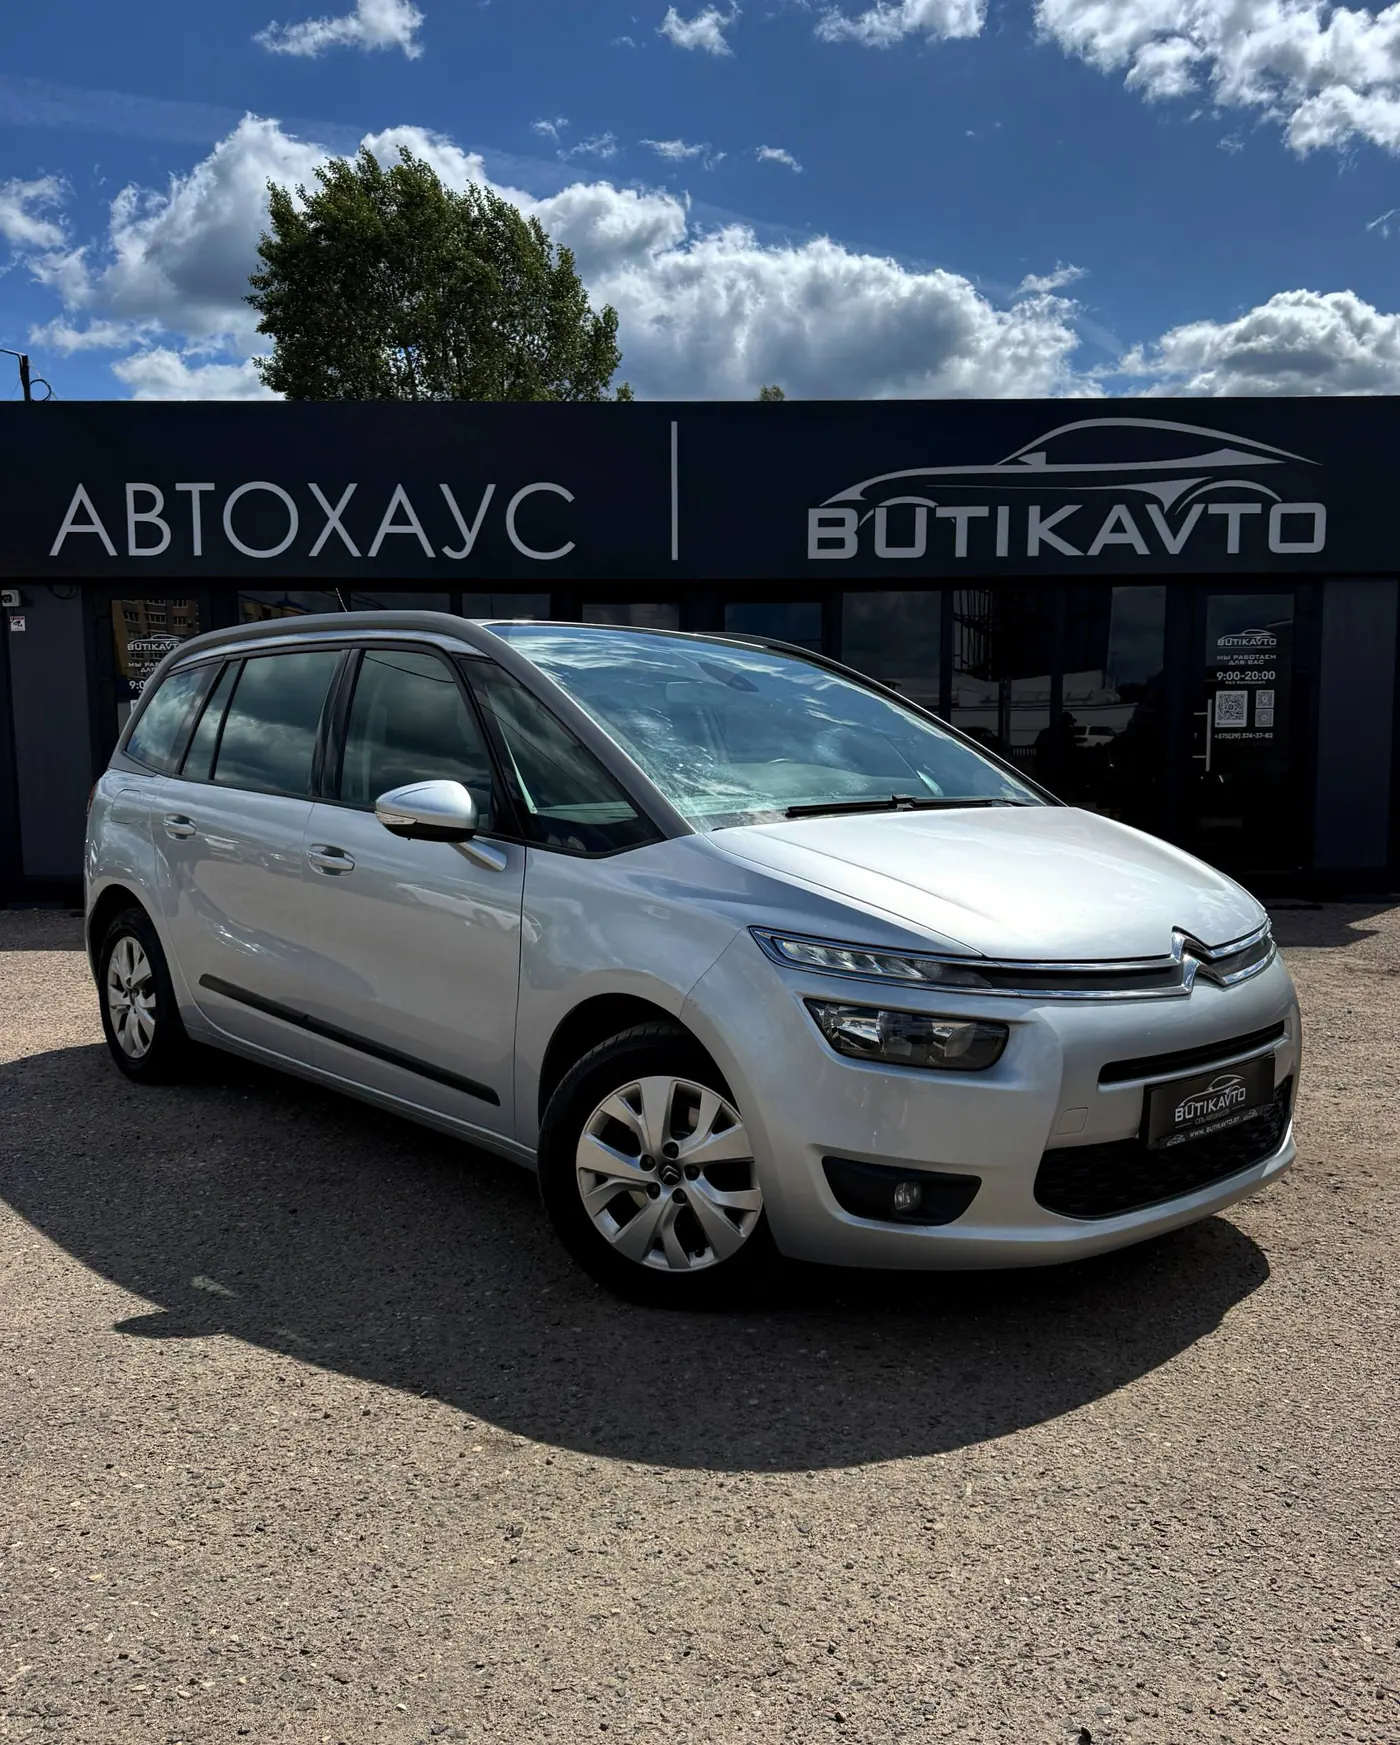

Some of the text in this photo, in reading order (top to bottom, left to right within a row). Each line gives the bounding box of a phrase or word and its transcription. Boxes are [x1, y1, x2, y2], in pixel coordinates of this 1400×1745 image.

[49, 480, 577, 561] АВТОХАУС
[806, 502, 1328, 560] BUTIKAVTO
[127, 643, 180, 651] BUTIKAVT
[1216, 671, 1276, 680] 9:00-20:00
[1175, 1088, 1246, 1122] BUTIKAVTO
